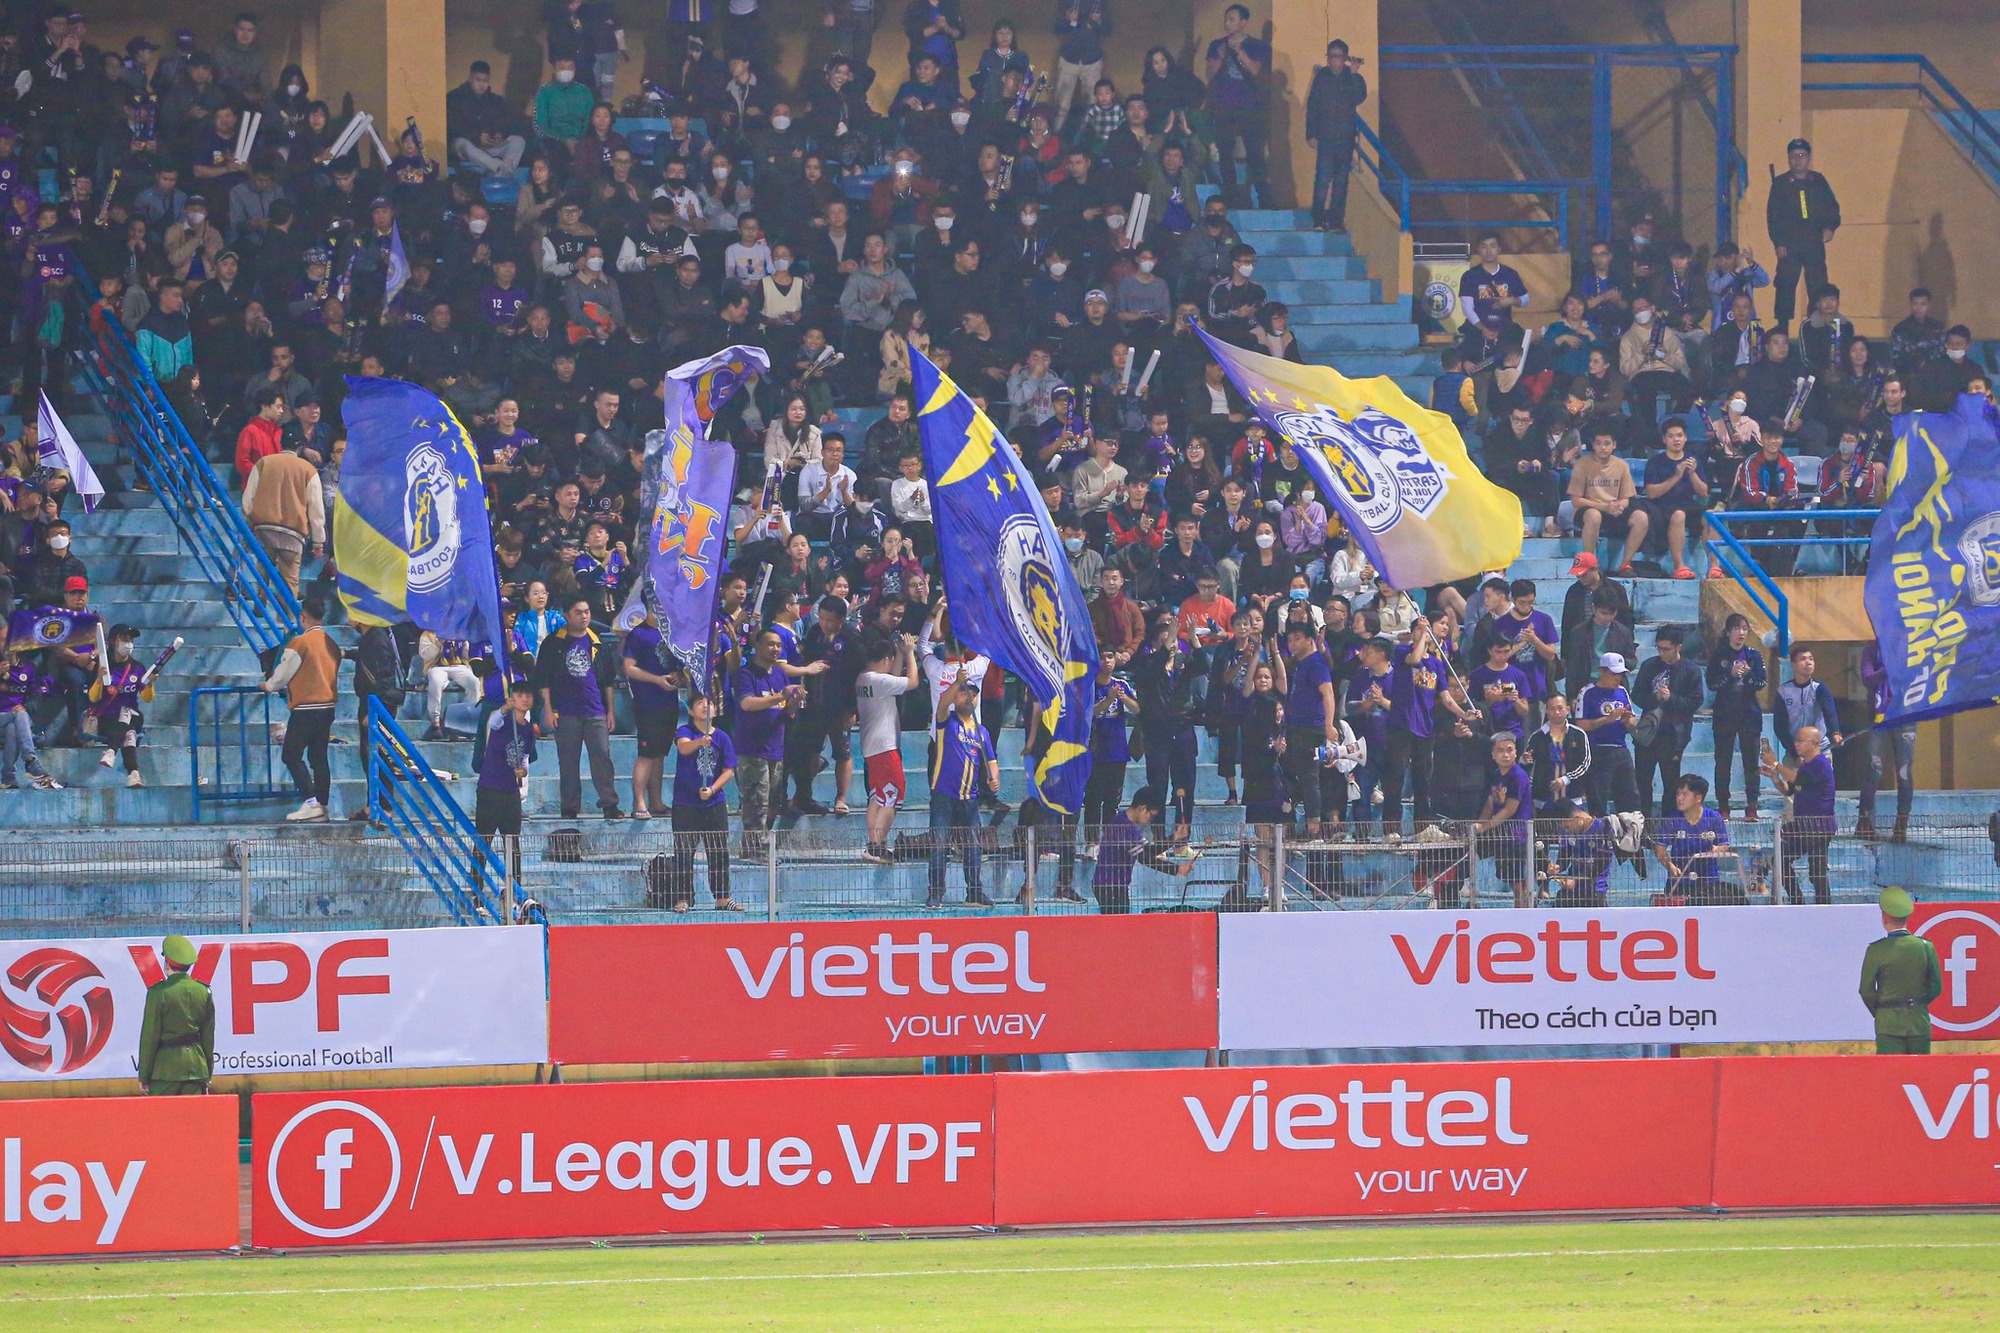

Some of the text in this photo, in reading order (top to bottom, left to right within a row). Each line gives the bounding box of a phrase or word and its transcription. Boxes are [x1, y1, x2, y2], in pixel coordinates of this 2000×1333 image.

[10, 226, 21, 235] 12
[37, 254, 47, 262] 12
[492, 299, 503, 308] 12
[1427, 285, 1450, 294] HANOI
[1375, 472, 1390, 499] CLUB
[724, 930, 1047, 999] viettel
[1390, 918, 1717, 985] viettel
[885, 1013, 1047, 1043] your way
[1475, 1003, 1717, 1032] Theo cách của bạn
[213, 1046, 394, 1070] Professional Football
[1183, 1077, 1529, 1152] viettel
[1902, 1068, 2000, 1139] vi
[3, 1137, 147, 1245] lay
[1354, 1167, 1529, 1200] your way
